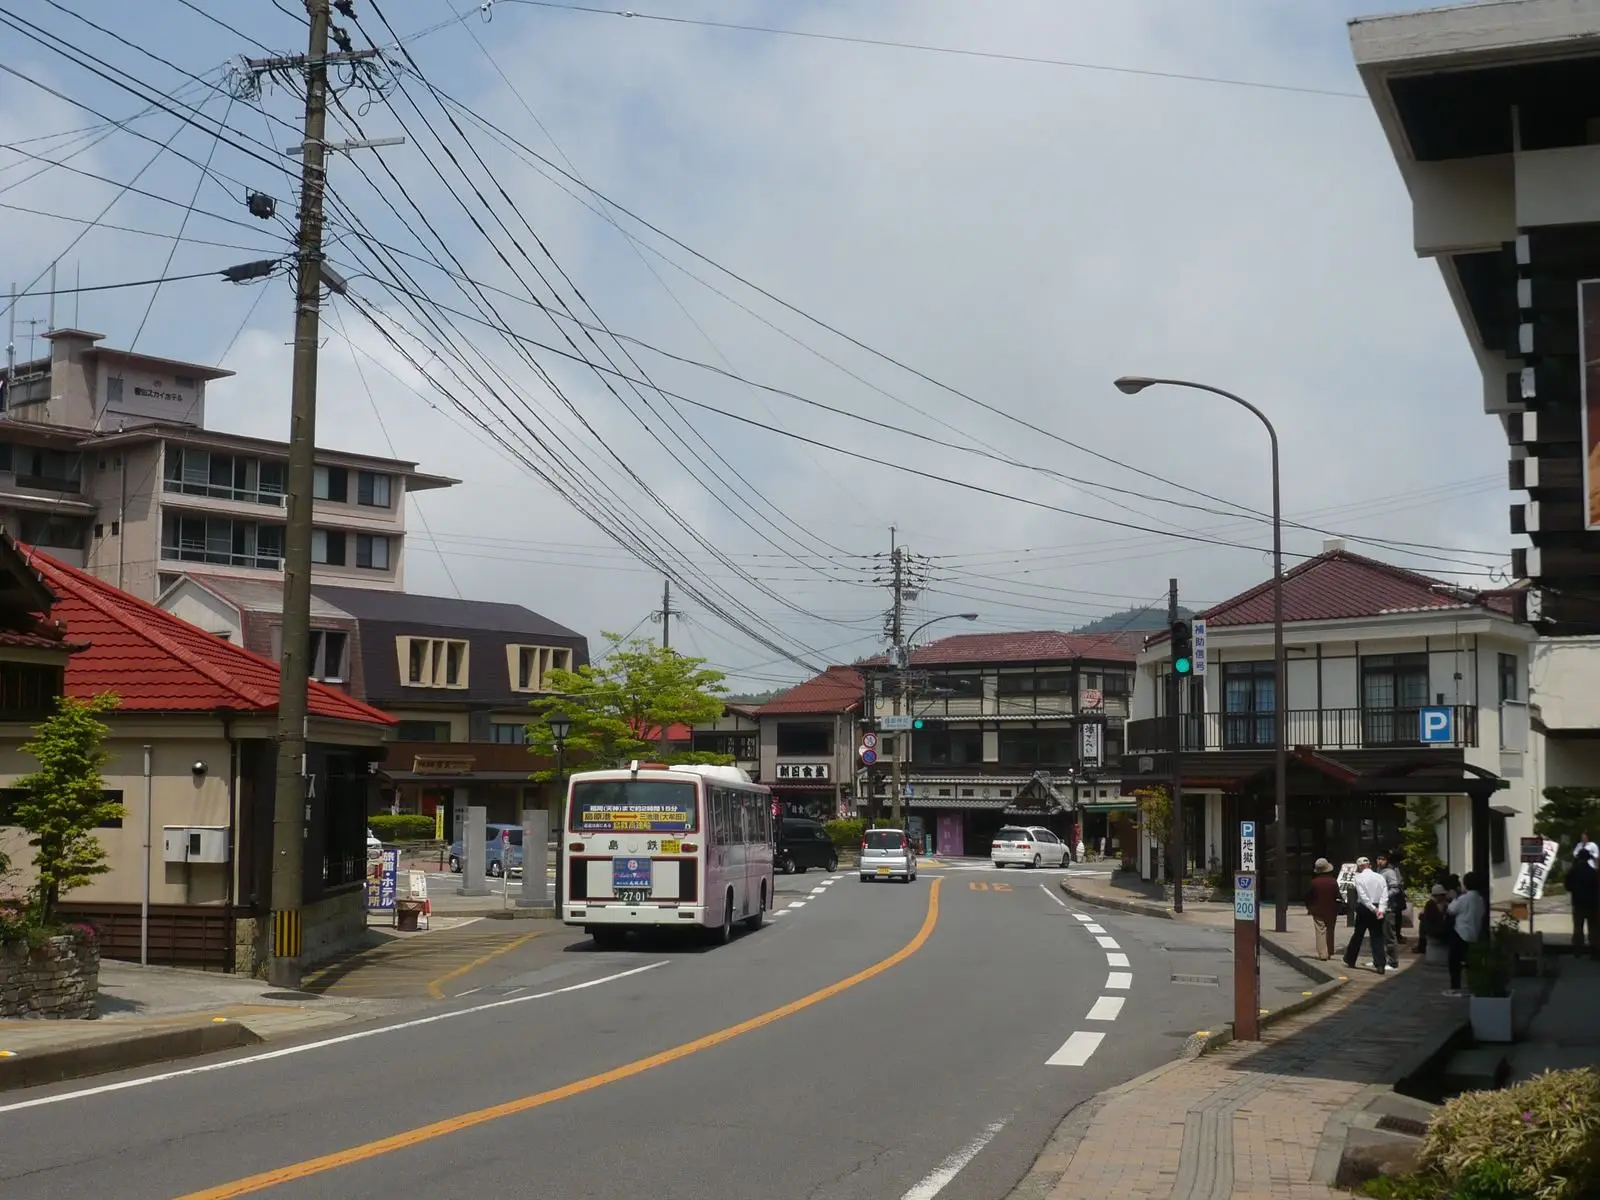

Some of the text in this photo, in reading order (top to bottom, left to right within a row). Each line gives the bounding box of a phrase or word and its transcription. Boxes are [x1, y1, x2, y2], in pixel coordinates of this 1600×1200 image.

[1194, 624, 1205, 672] 補助信号
[1424, 711, 1448, 740] P
[779, 765, 825, 778] 朝日食堂
[1243, 824, 1253, 836] P
[608, 840, 619, 850] 島
[647, 840, 658, 851] 鉄
[1240, 878, 1249, 886] 57
[1236, 903, 1254, 914] 200
